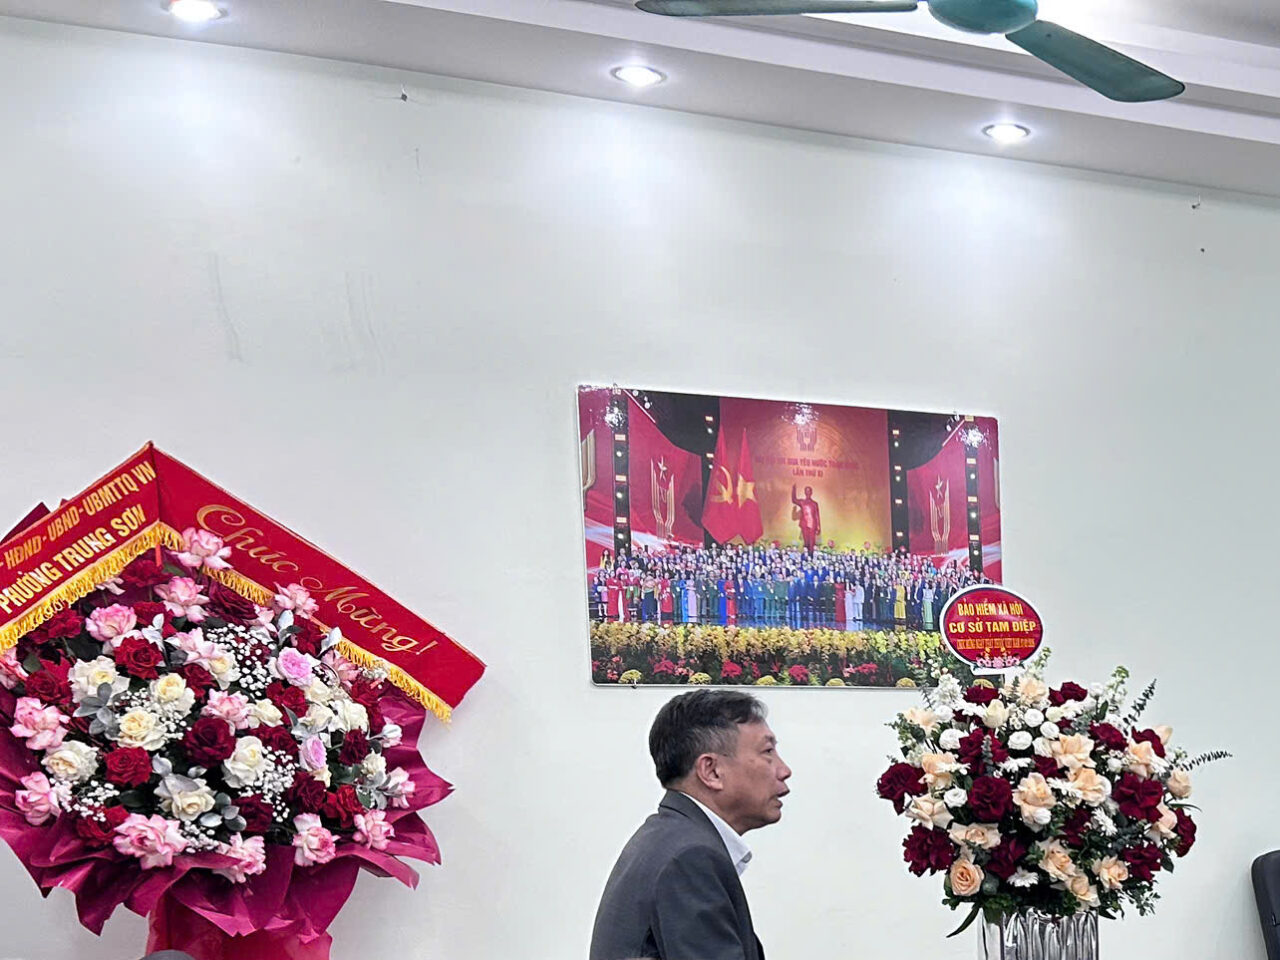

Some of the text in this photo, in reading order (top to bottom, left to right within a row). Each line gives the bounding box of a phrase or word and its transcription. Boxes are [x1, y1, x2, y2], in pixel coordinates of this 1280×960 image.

[131, 461, 156, 485] VN
[53, 527, 117, 572] TRUNG
[110, 503, 147, 537] SƠN
[957, 598, 975, 616] BẢO
[975, 598, 997, 616] HIỂM
[1009, 600, 1024, 618] HỘI
[949, 617, 1036, 634] CƠ SỞ TAM ĐIỆP
